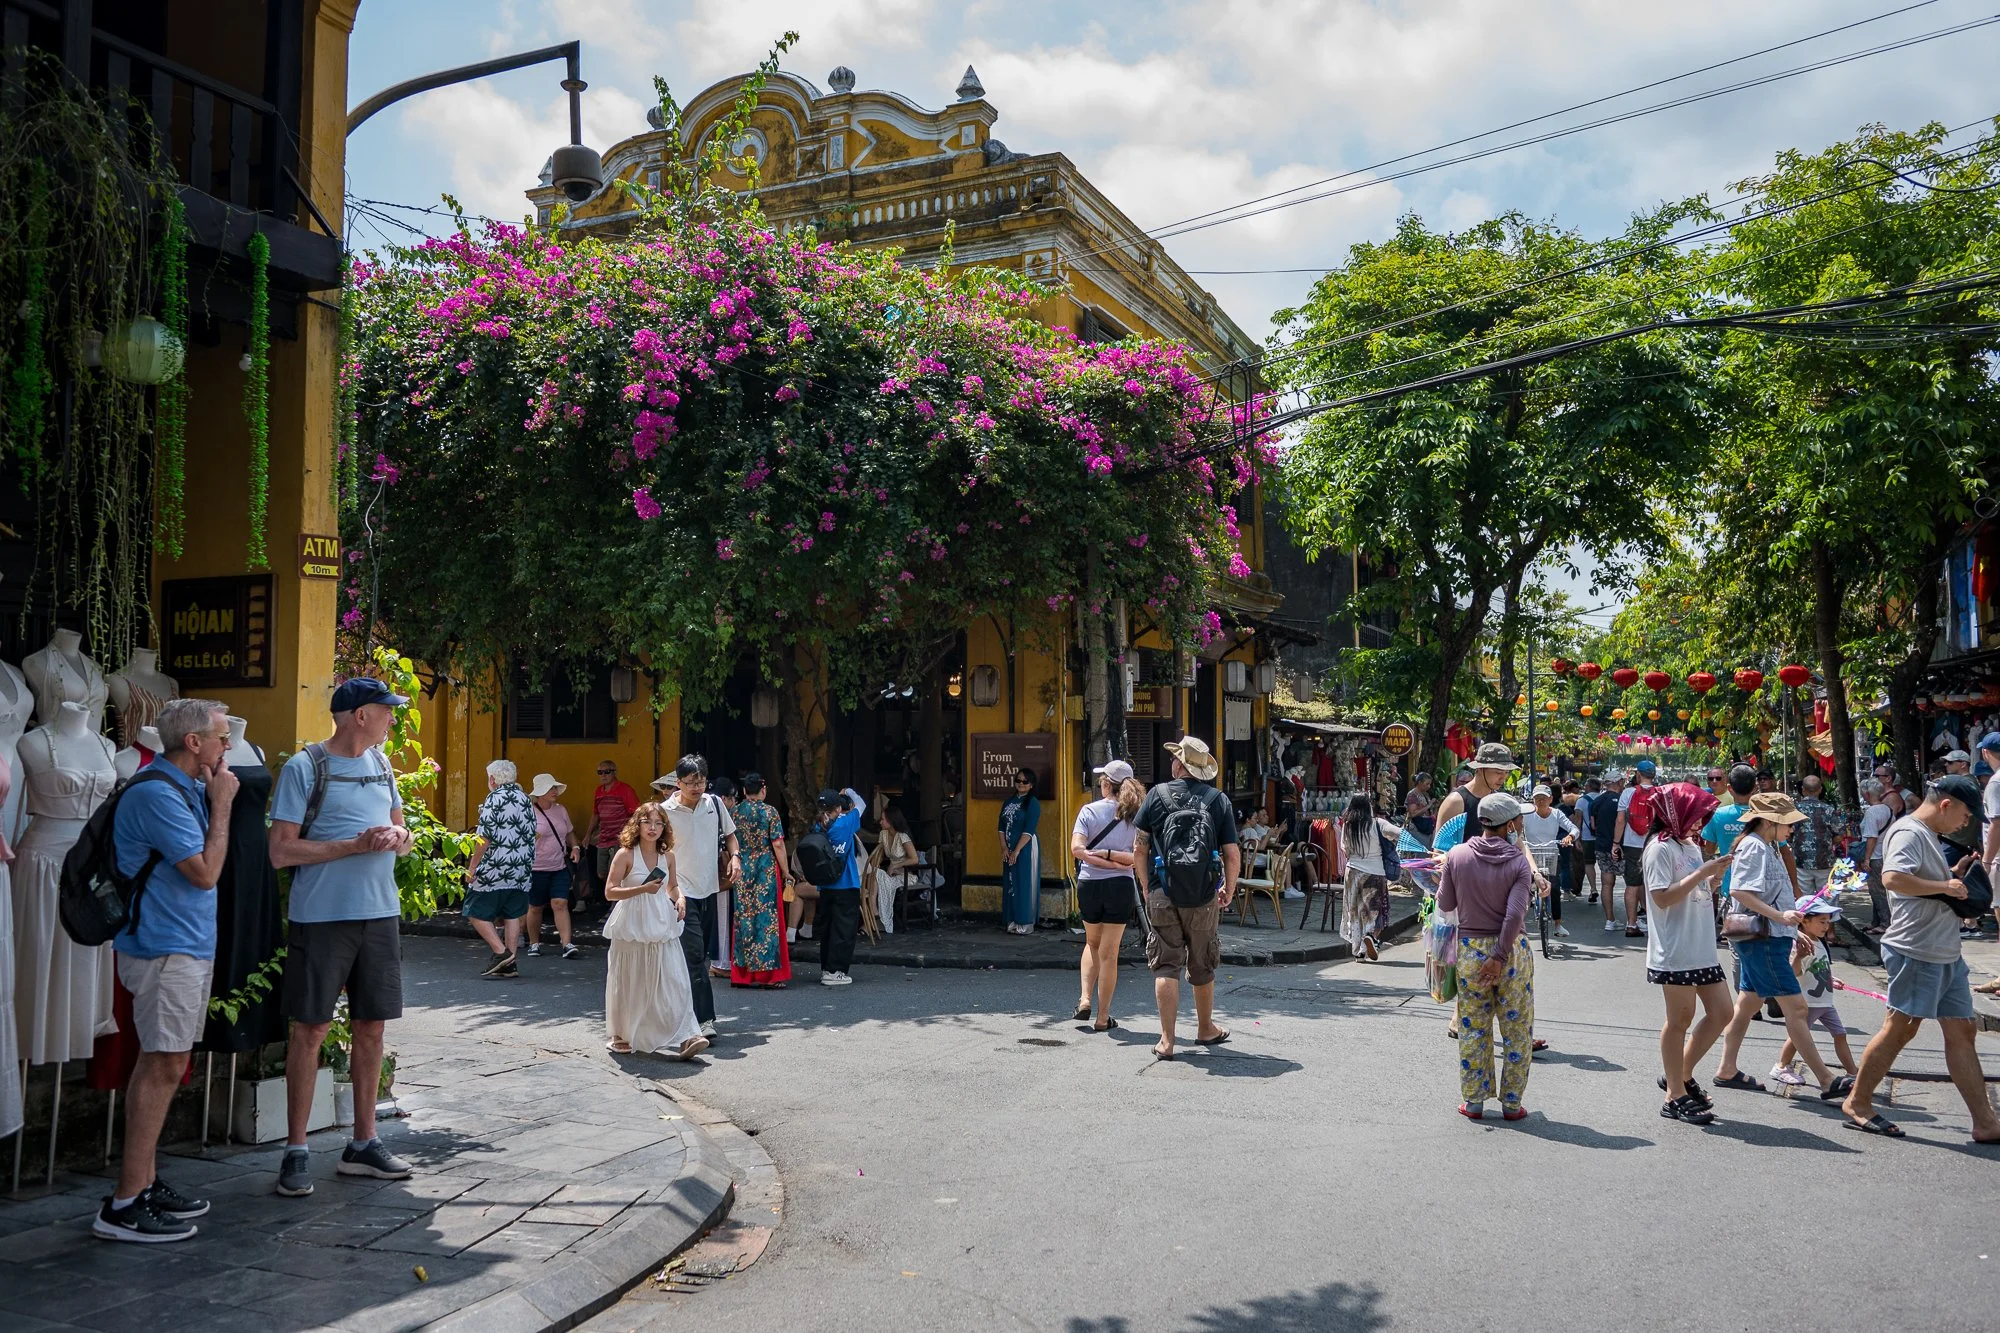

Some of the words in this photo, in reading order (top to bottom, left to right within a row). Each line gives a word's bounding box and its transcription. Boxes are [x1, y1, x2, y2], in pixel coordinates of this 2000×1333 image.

[303, 537, 338, 559] ATM
[311, 565, 331, 574] 10m
[1388, 728, 1407, 736] MINI
[1384, 737, 1410, 747] MART
[982, 751, 1012, 762] From
[983, 764, 1001, 775] Hoi
[1003, 764, 1019, 775] An
[983, 776, 1008, 787] with
